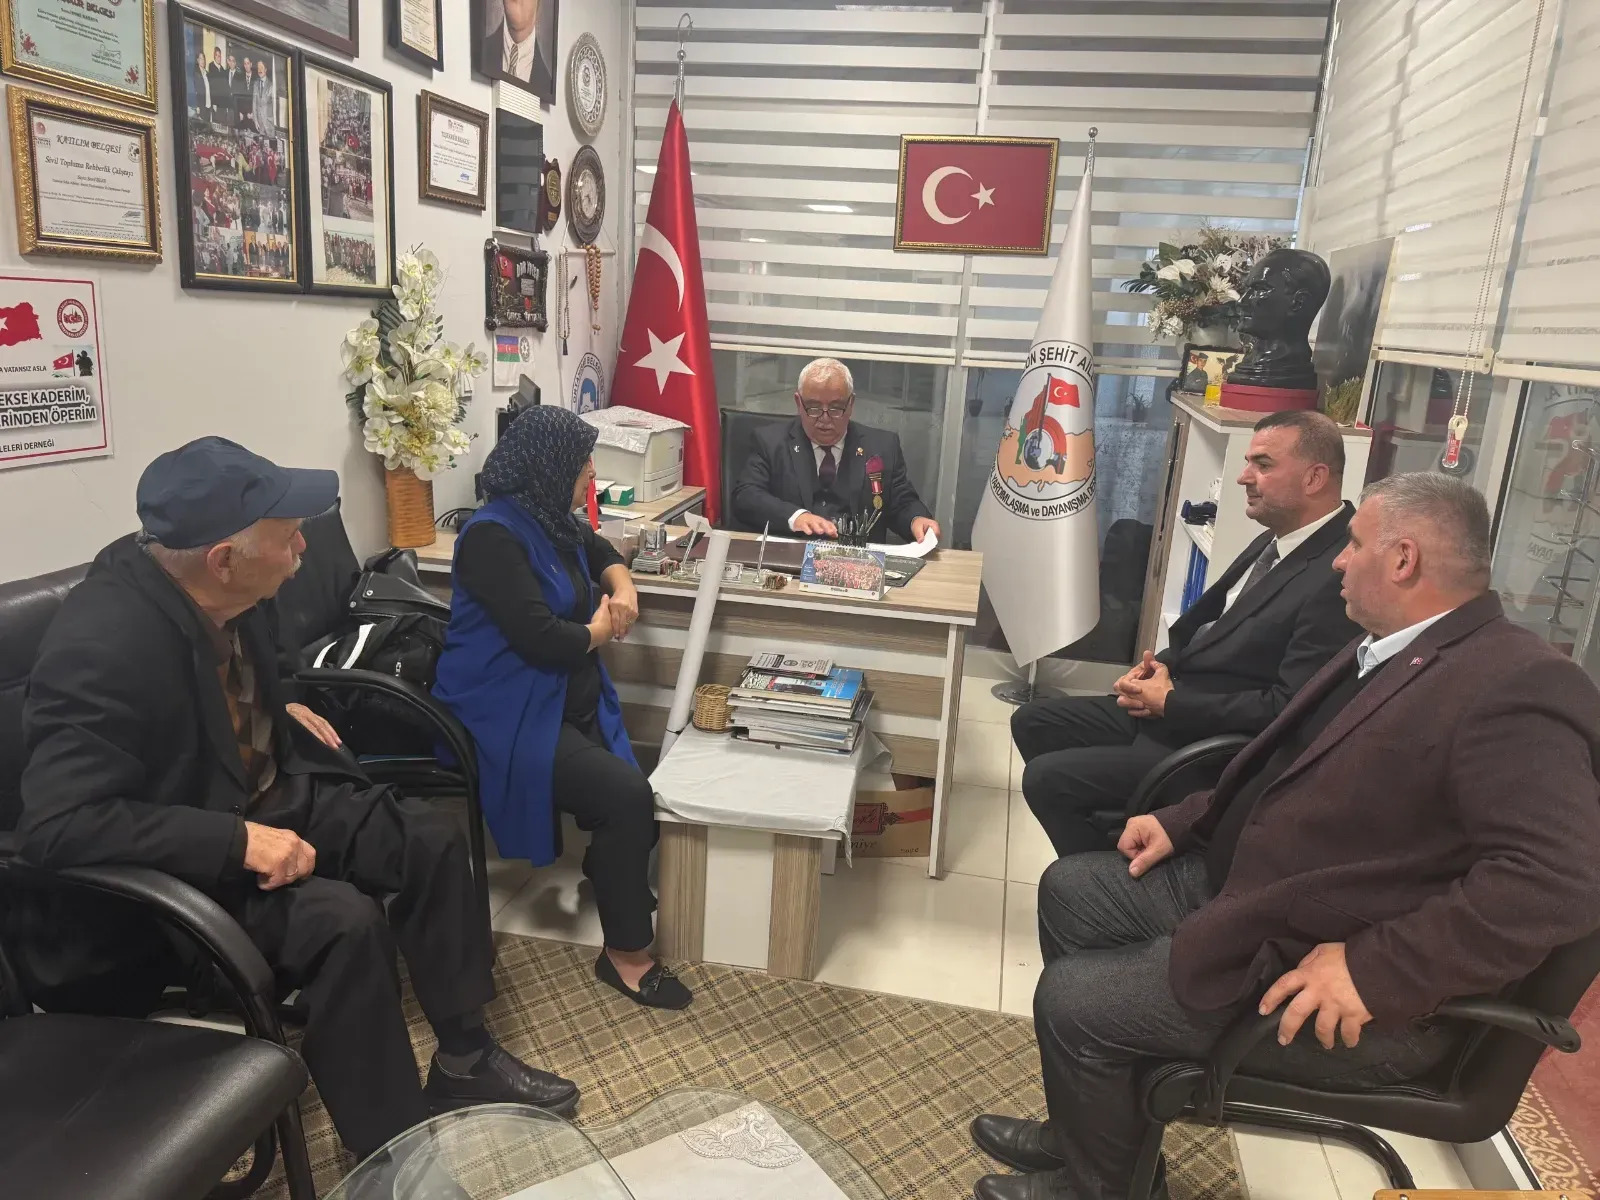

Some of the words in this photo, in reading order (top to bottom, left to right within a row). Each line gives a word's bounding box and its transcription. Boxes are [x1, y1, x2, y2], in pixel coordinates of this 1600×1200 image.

[56, 134, 90, 148] KATILIM
[91, 140, 122, 154] BELGESİ
[45, 155, 59, 165] Sivil
[1039, 345, 1079, 365] ŞEHİT
[31, 387, 89, 404] KADERİM,
[0, 411, 49, 427] RİNDEN
[51, 406, 96, 423] ÖPERİM
[24, 438, 55, 450] DERNEĞİ
[991, 473, 1030, 516] YARDIMLAŞMA
[1030, 507, 1040, 517] ve
[1041, 491, 1090, 517] DAYANIŞMA
